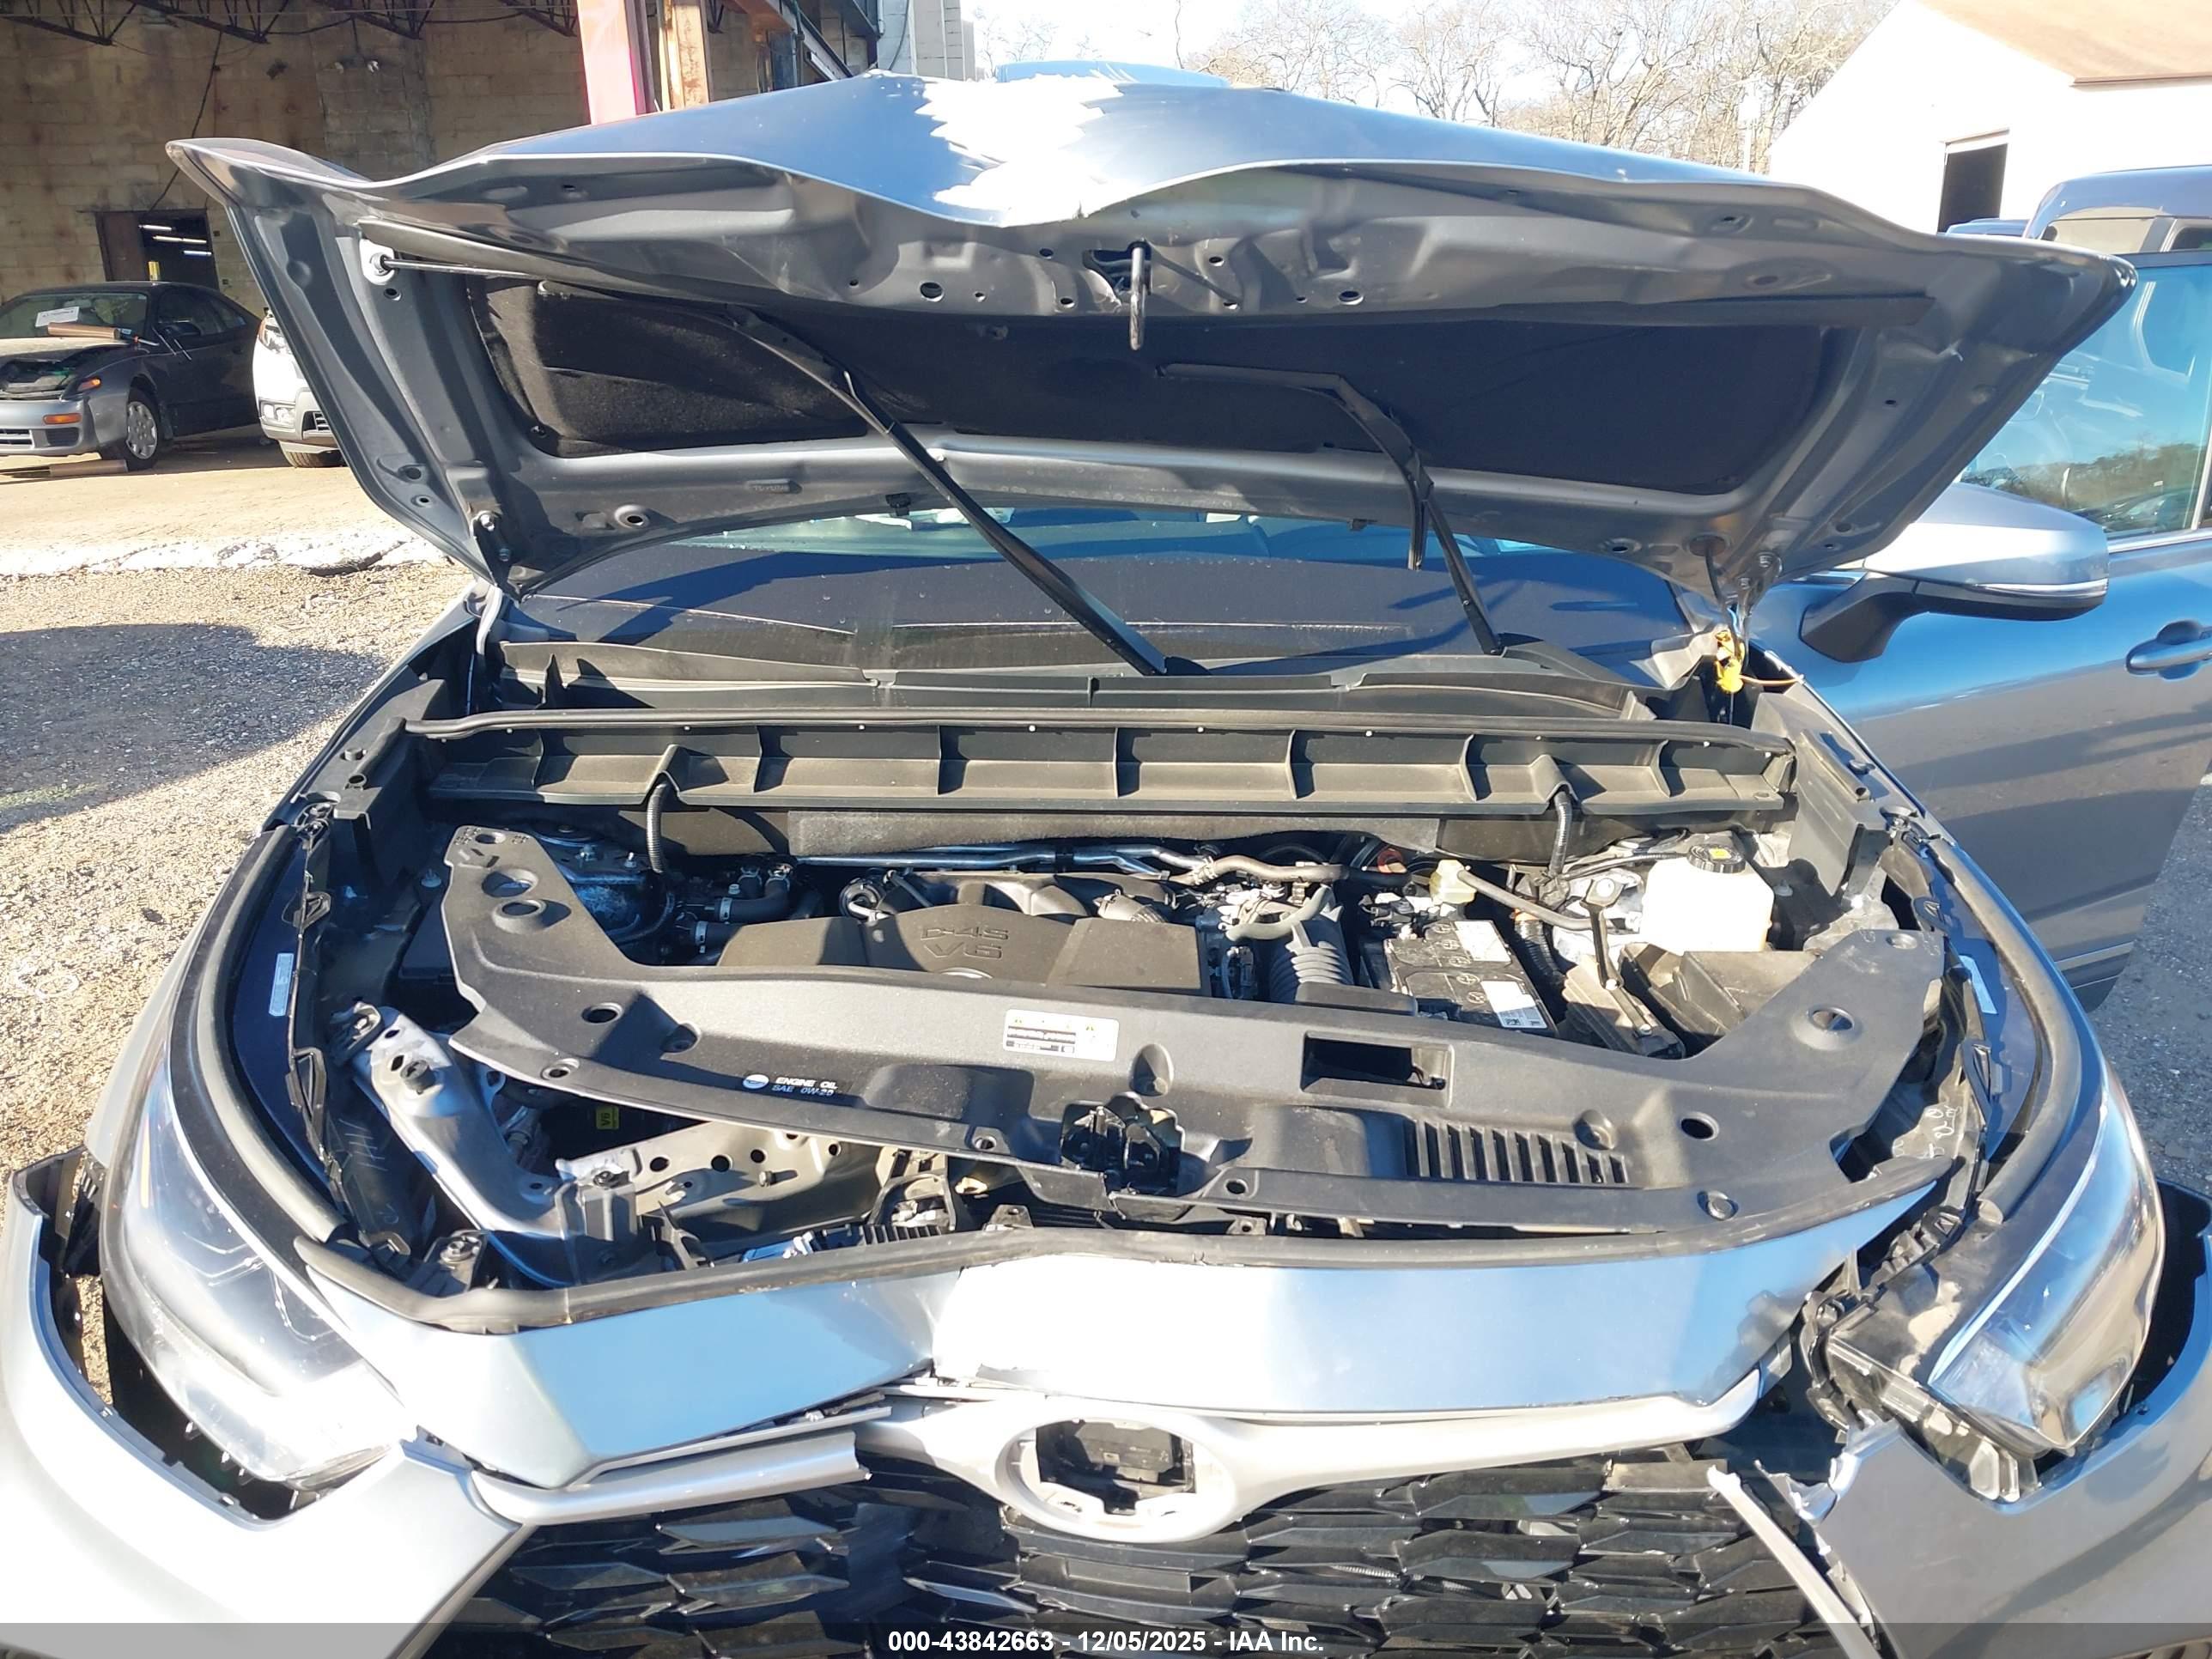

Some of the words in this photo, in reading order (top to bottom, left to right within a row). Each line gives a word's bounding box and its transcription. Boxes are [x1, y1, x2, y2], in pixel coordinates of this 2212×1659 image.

[924, 942, 1002, 960] V6
[772, 1085, 794, 1093] SAE
[775, 1077, 816, 1088] ENGINE
[820, 1081, 838, 1090] OIL
